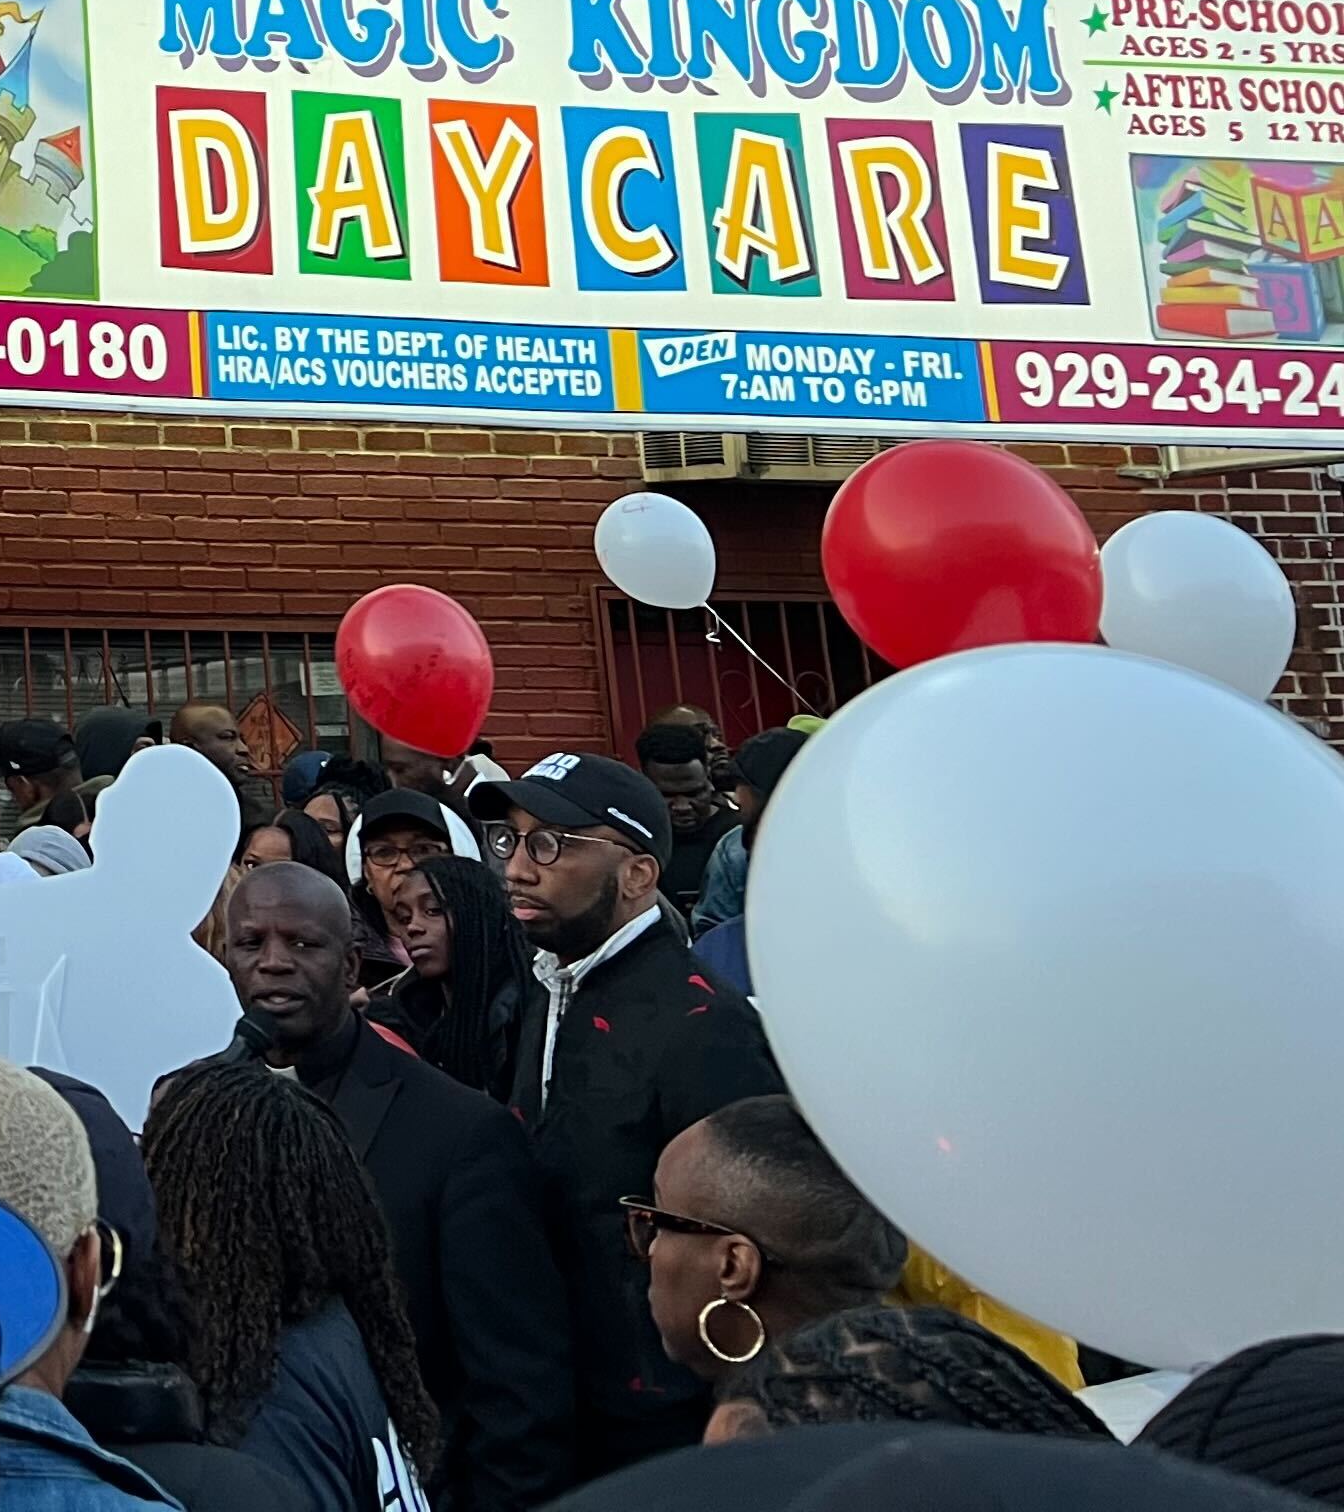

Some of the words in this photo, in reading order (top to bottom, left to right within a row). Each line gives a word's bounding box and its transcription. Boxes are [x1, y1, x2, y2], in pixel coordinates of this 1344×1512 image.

[1120, 34, 1208, 58] AGES
[1216, 42, 1234, 60] 2
[1260, 44, 1276, 64] 5
[1121, 72, 1232, 111] AFTER
[1127, 113, 1206, 137] AGES
[1228, 122, 1244, 142] 5
[1268, 123, 1299, 142] 12
[168, 107, 1069, 291] DAYCARE
[217, 324, 267, 351] LIC.
[274, 326, 310, 353] BY
[317, 328, 371, 354] THE
[377, 330, 447, 358] DEPT.
[455, 333, 489, 359] OF
[496, 336, 597, 364] HEALTH
[658, 338, 729, 367] OPEN
[745, 343, 876, 376] MONDAY
[902, 350, 963, 380] FRI.
[218, 354, 326, 390] HRA/ACS
[332, 358, 469, 392] VOUCHERS
[474, 364, 602, 397] ACCEPTED
[721, 373, 795, 402] 7:AM
[802, 376, 846, 405] TO
[855, 379, 928, 407] 6:PM
